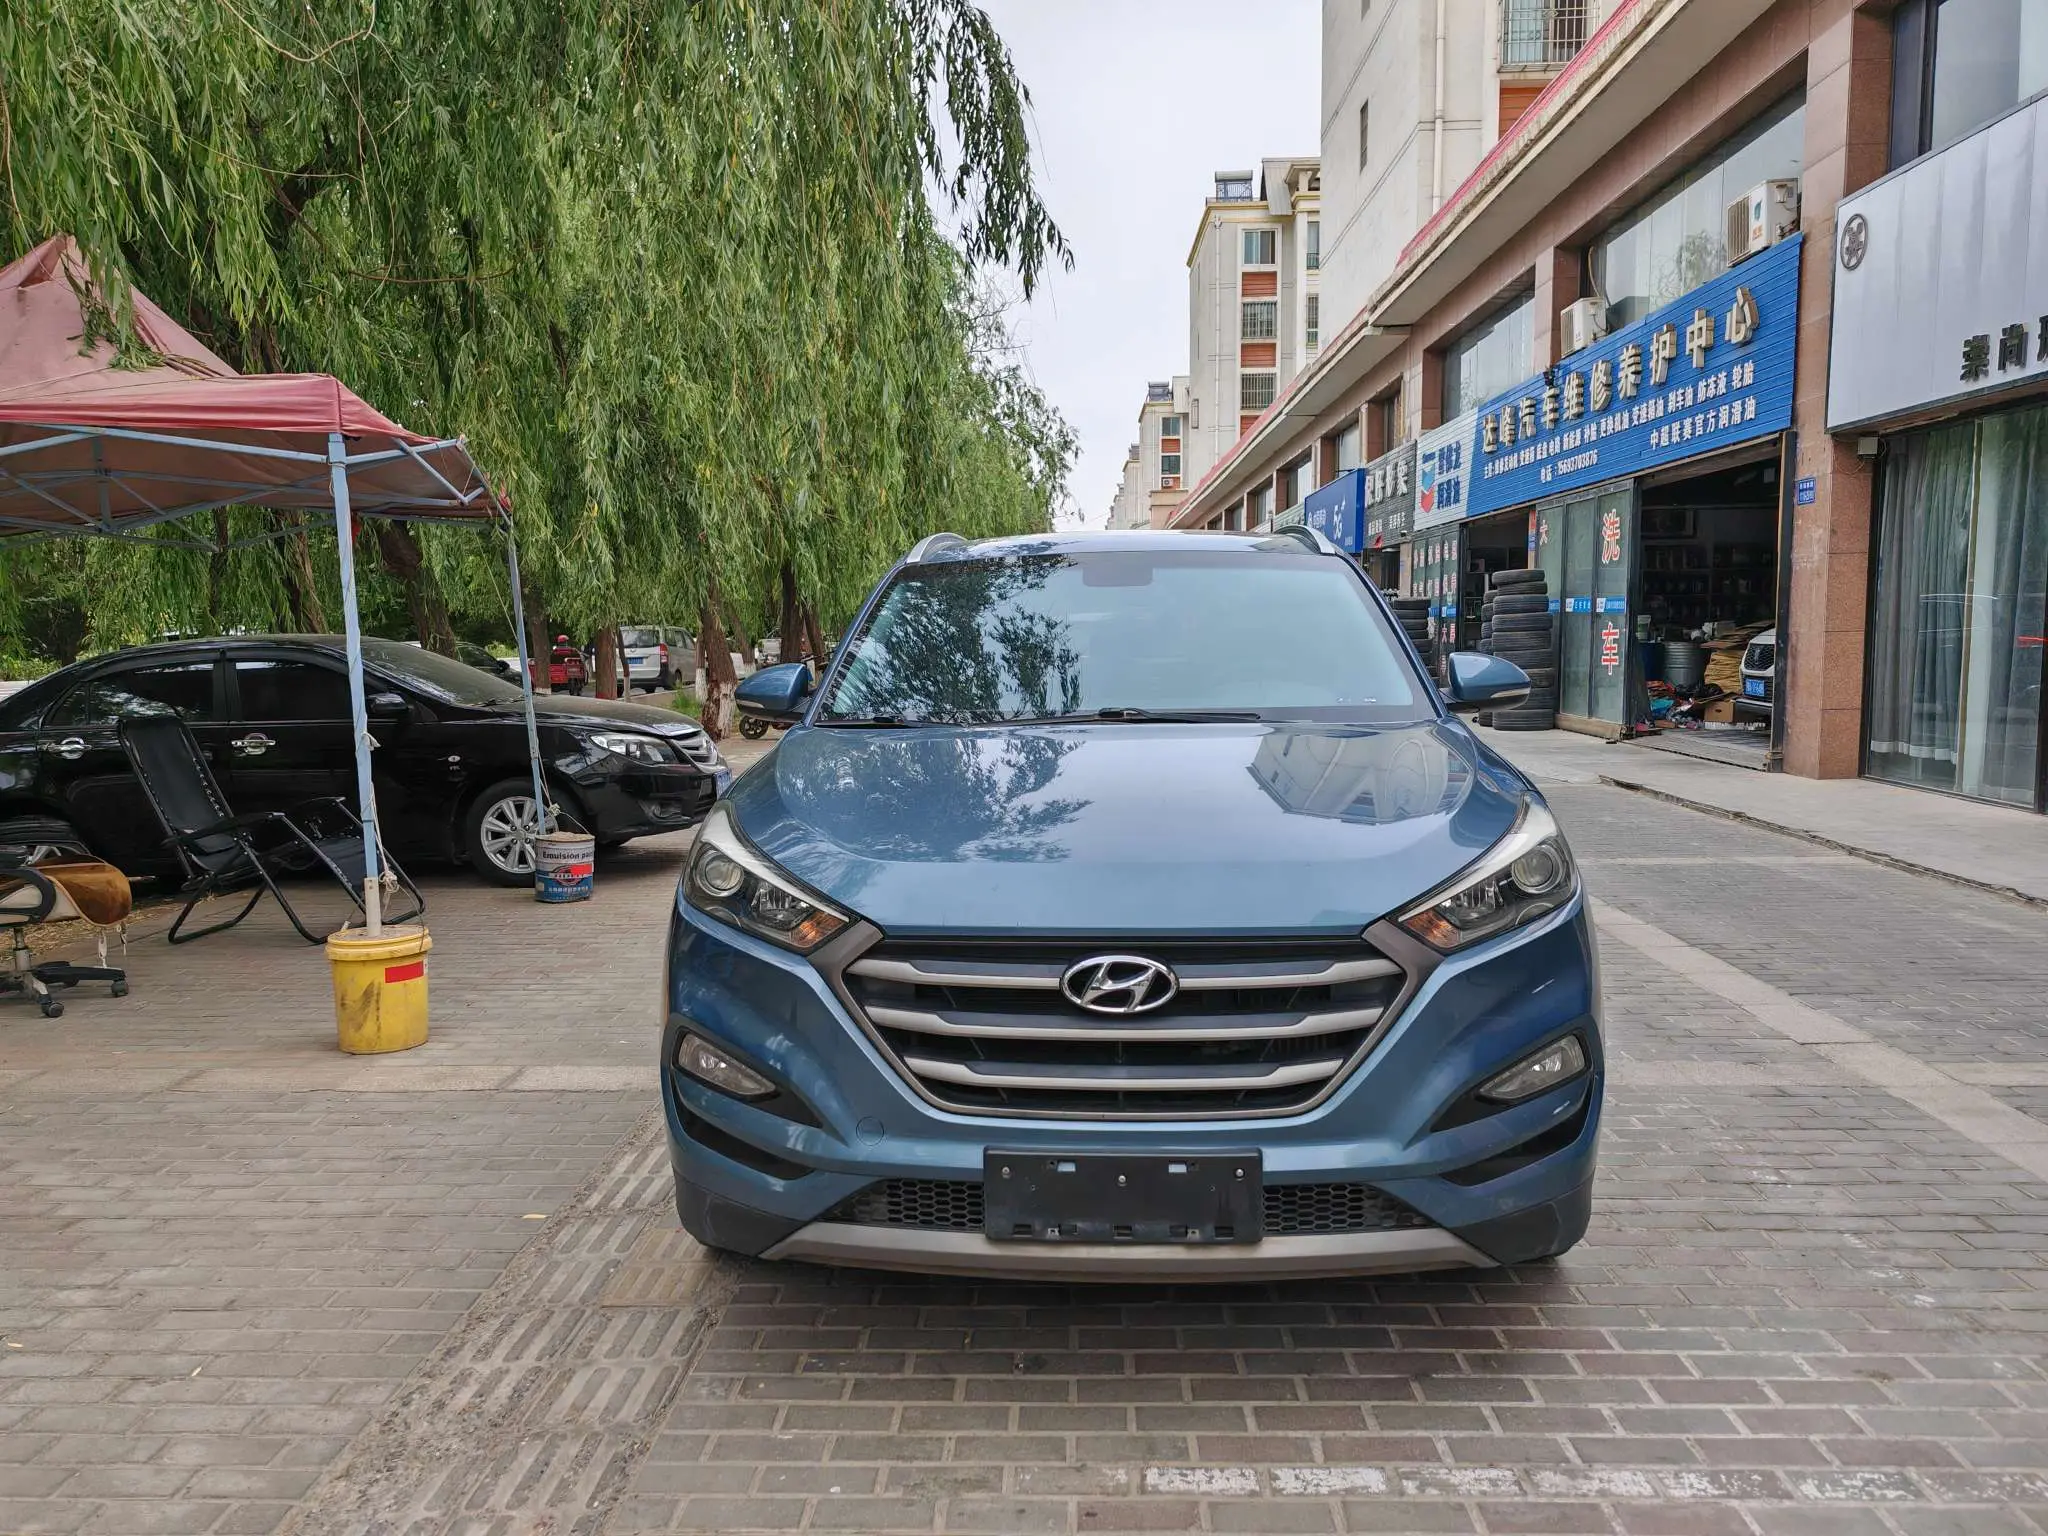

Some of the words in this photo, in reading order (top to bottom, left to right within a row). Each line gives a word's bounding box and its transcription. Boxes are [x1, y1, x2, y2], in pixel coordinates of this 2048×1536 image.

[1697, 371, 1727, 403] 防冻液
[1731, 360, 1755, 390] 轮胎
[1650, 395, 1757, 450] 中超联赛官方润滑油
[543, 851, 580, 860] Emulsion
